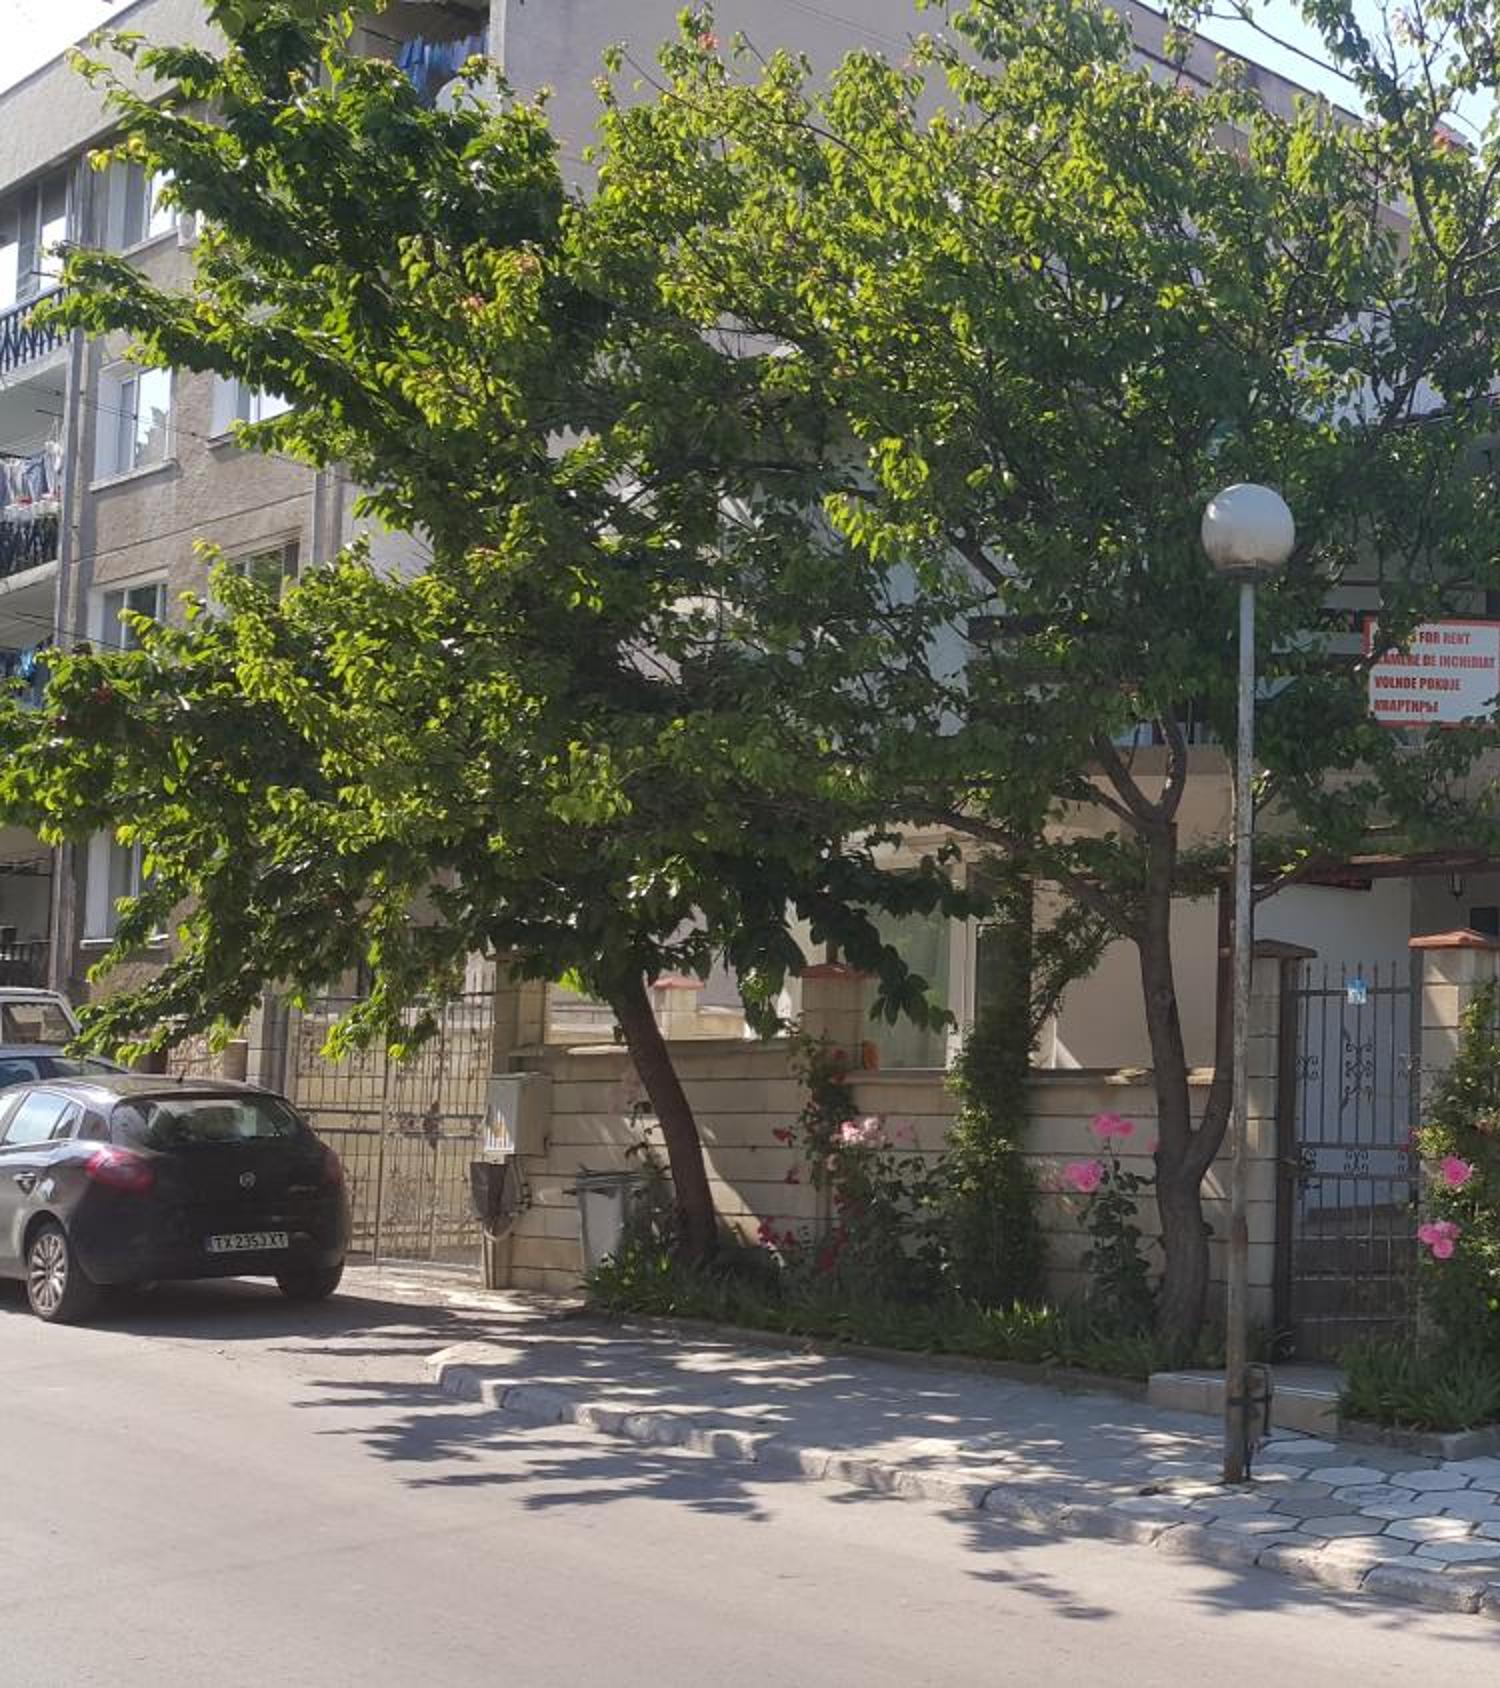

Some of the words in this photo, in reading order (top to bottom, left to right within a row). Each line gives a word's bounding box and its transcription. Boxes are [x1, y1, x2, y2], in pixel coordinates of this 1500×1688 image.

[1419, 631, 1441, 644] FOR
[1443, 631, 1471, 645] RENT
[1423, 654, 1437, 667] DE
